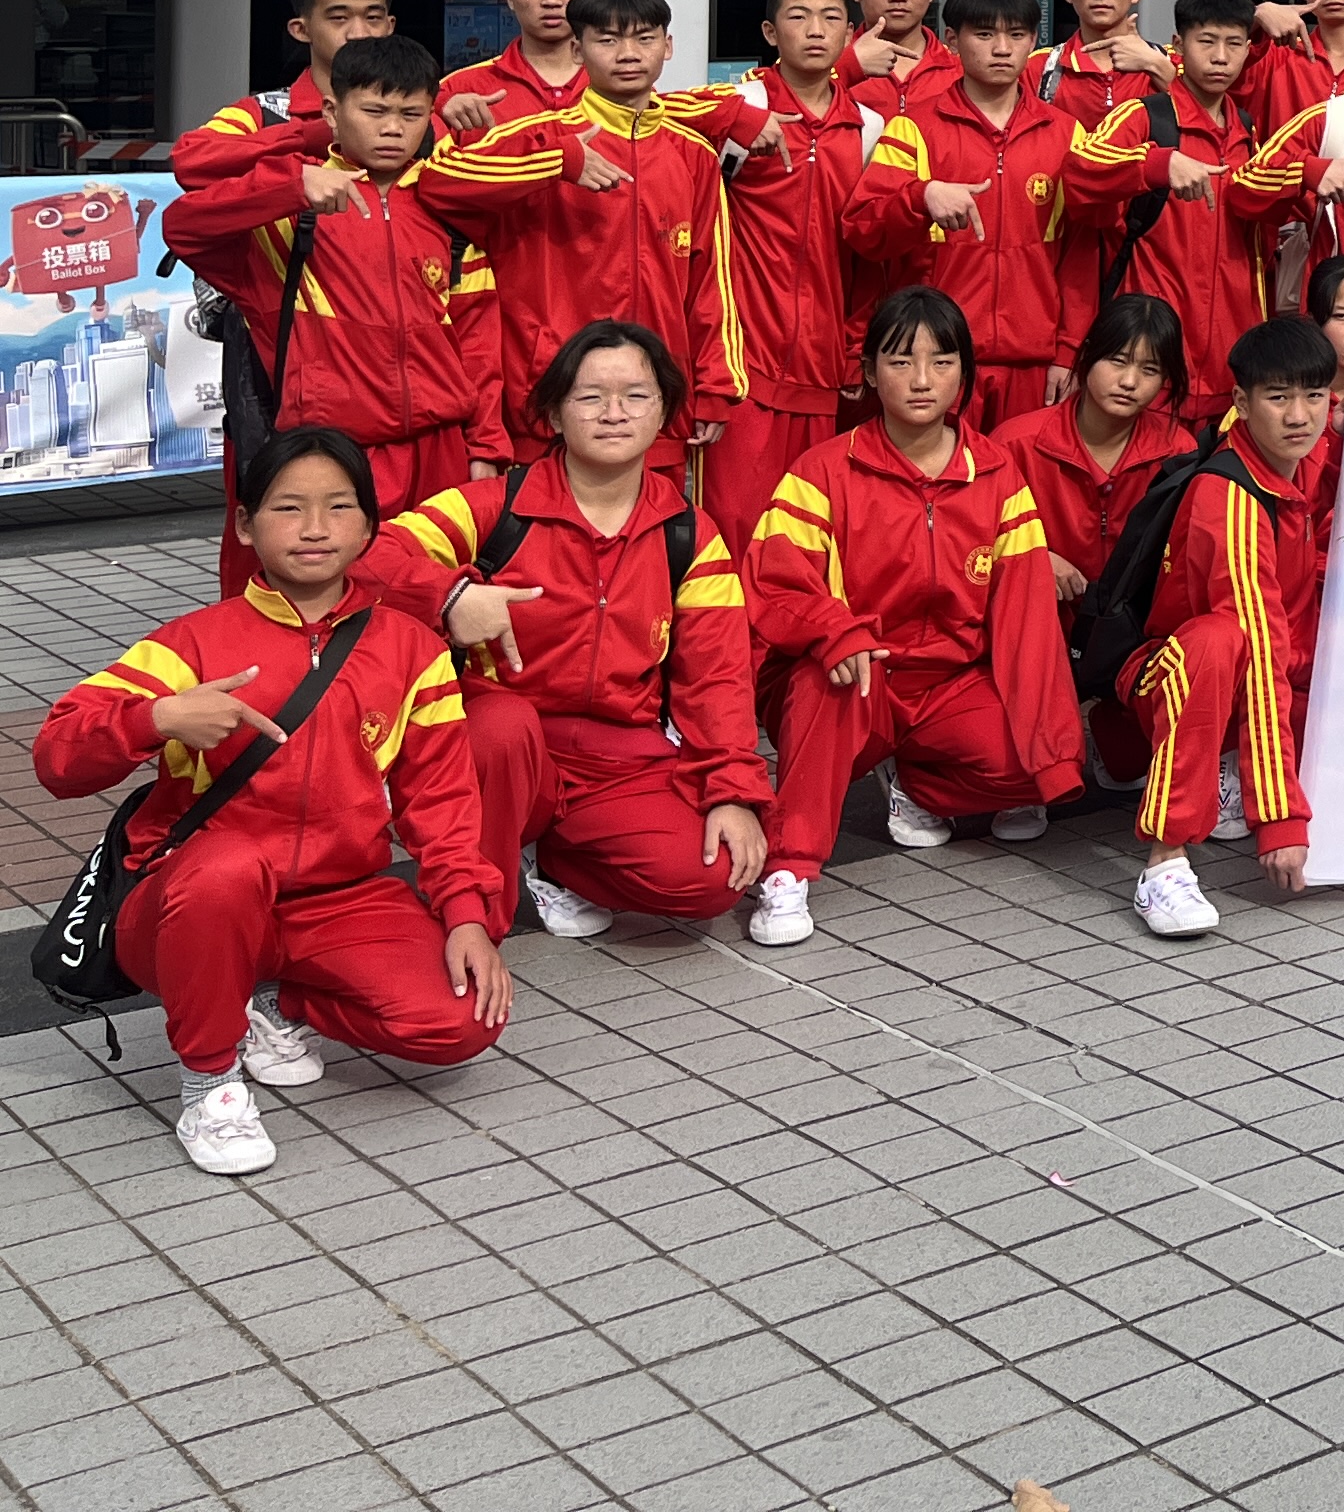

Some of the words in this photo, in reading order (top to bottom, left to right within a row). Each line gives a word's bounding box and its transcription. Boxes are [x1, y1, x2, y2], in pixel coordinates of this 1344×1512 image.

[42, 239, 111, 270] 投票箱
[51, 267, 83, 281] Ballot
[84, 264, 106, 276] Box
